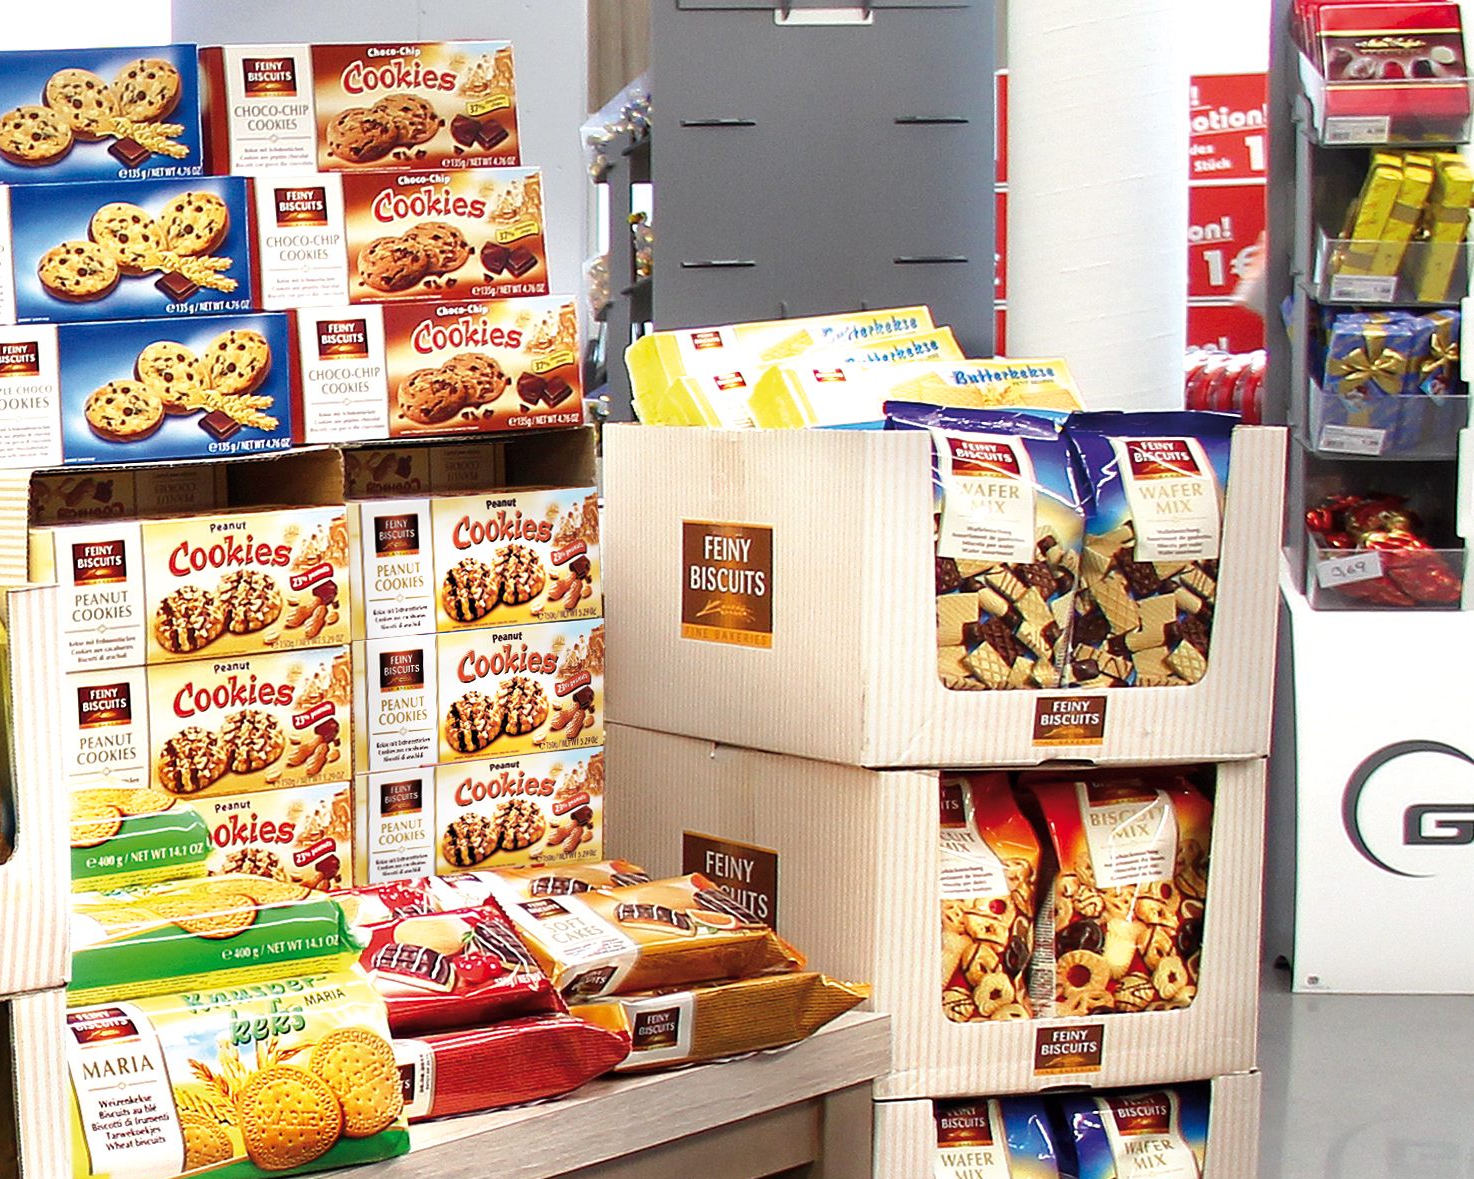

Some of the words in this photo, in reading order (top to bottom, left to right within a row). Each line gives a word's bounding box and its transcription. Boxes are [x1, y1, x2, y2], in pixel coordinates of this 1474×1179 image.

[368, 47, 421, 58] Choco-Chip
[342, 58, 457, 94] Cookies
[234, 105, 309, 118] CHOCO-CHIP
[1190, 104, 1267, 132] otion!
[248, 119, 298, 132] COOKIES
[1244, 135, 1266, 170] 1
[1194, 158, 1232, 172] Stück
[398, 174, 450, 186] Choco-Chip
[373, 188, 486, 222] Cookies
[266, 235, 340, 248] CHOCO-CHIP
[279, 249, 328, 261] COOKIES
[437, 306, 488, 317] Choco-Chip
[413, 319, 522, 353] Cookies
[308, 367, 380, 381] CHOCO-CHIP
[954, 366, 1054, 386] Butterkekse
[15, 384, 53, 395] CHOCO
[321, 381, 369, 394] COOKIES
[219, 441, 231, 452] 135
[241, 440, 253, 451] NET
[254, 439, 265, 449] WT
[279, 437, 290, 448] OZ
[959, 482, 1020, 499] WAFER
[1138, 483, 1204, 498] WAFER
[486, 498, 516, 509] Peanut
[1155, 500, 1192, 514] MIX
[210, 522, 247, 533] Peanut
[452, 511, 553, 549] Cookies
[168, 536, 292, 577] Cookies
[704, 535, 751, 563] FEINY
[377, 562, 420, 576] PEANUT
[375, 576, 424, 591] COOKIES
[690, 565, 765, 596] BISCUITS
[75, 591, 129, 607] PEANUT
[72, 606, 133, 623] COOKIES
[492, 632, 522, 643] Peanut
[214, 662, 250, 674] Peanut
[457, 643, 558, 683] Cookies
[173, 675, 295, 718] Cookies
[381, 696, 424, 711] PEANUT
[378, 710, 427, 726] COOKIES
[80, 733, 132, 749] PEANUT
[77, 747, 136, 766] COOKIES
[490, 761, 520, 771] Peanut
[454, 771, 555, 807] Cookies
[215, 801, 250, 813] Peanut
[381, 819, 423, 833] PEANUT
[378, 830, 425, 846] COOKIES
[98, 855, 116, 868] 400
[116, 856, 123, 869] g
[131, 852, 149, 863] NET
[151, 850, 167, 861] WT
[169, 847, 188, 858] 14.1
[190, 844, 204, 855] OZ
[706, 851, 754, 882] FEINY
[542, 918, 584, 934] SOFT
[551, 923, 604, 945] CAKES
[180, 976, 326, 1013] Knusper-
[304, 988, 346, 1006] MARIA
[228, 997, 306, 1046] keks
[646, 1013, 670, 1026] FEINY
[82, 1054, 155, 1080] MARIA
[106, 1140, 134, 1151] Wheat
[135, 1136, 166, 1148] biscuits
[1125, 1139, 1173, 1155] WAFER
[940, 1153, 994, 1167] WAFER
[1133, 1154, 1166, 1170] MIX
